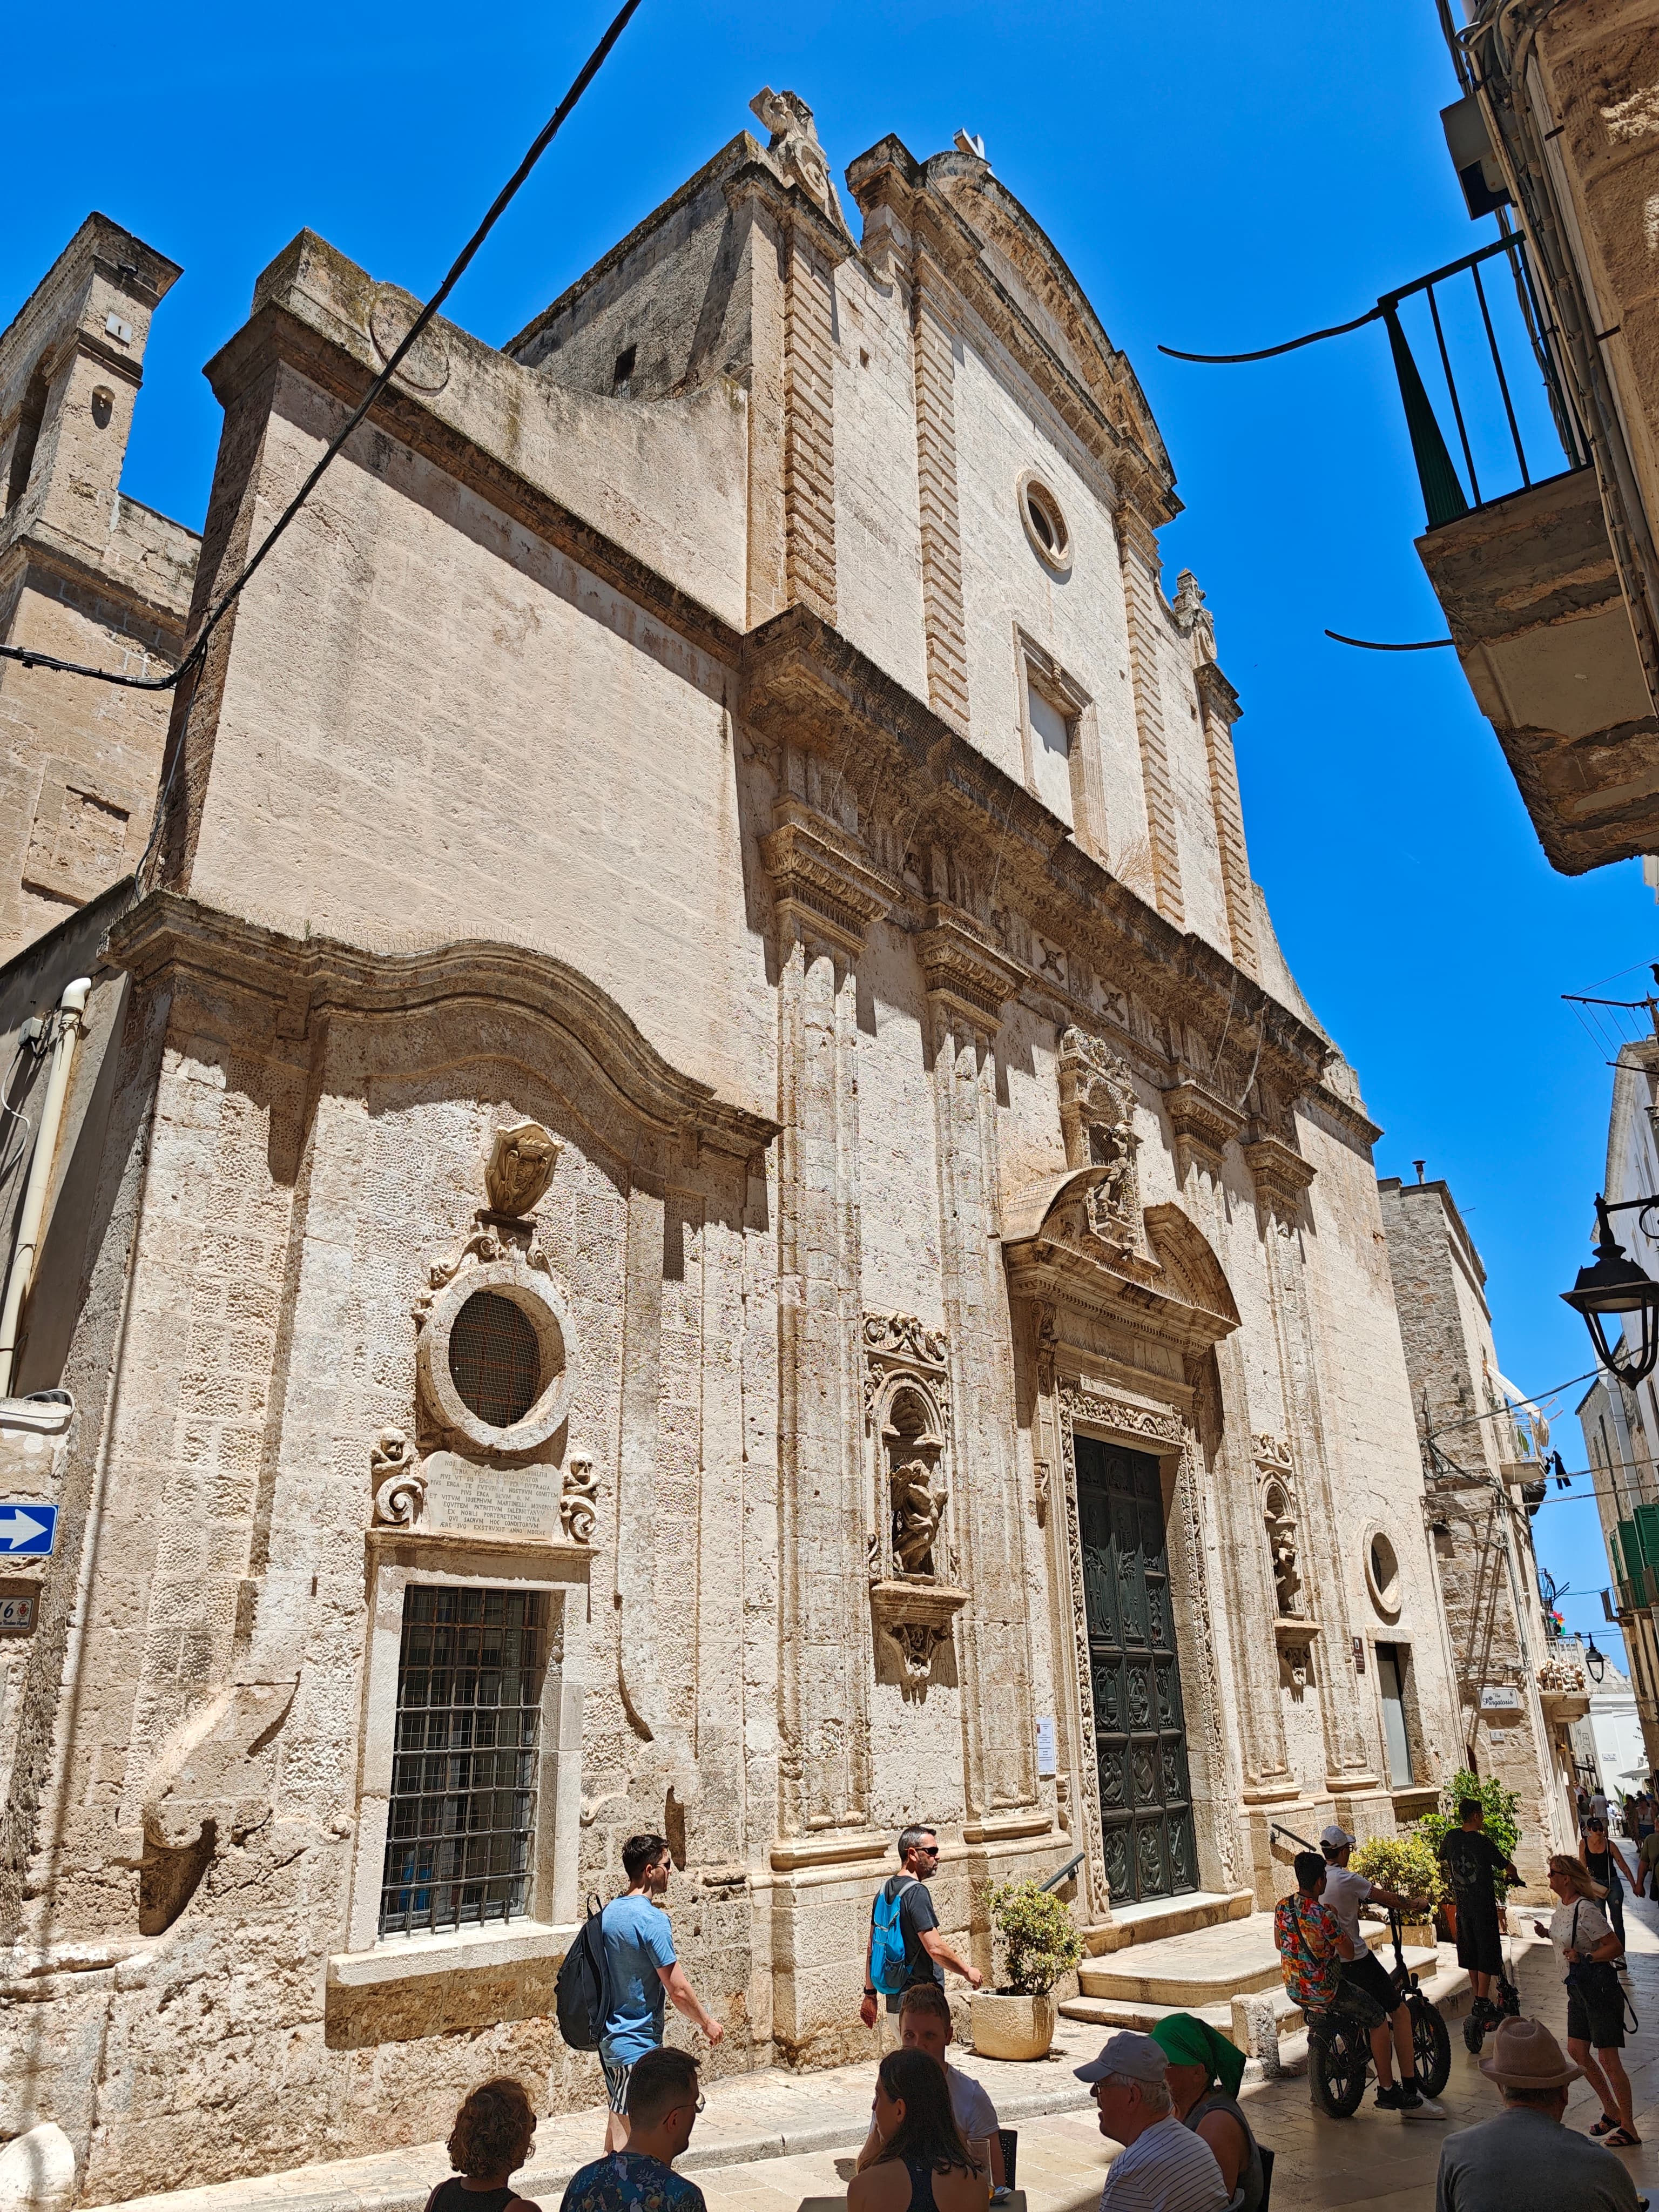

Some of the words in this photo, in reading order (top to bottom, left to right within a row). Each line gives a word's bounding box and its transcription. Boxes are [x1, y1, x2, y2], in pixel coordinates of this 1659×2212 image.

[474, 1504, 502, 1512] PATRITIVM
[507, 1507, 545, 1516] SALERNITANVM
[1482, 1697, 1514, 1708] Purgatorio
